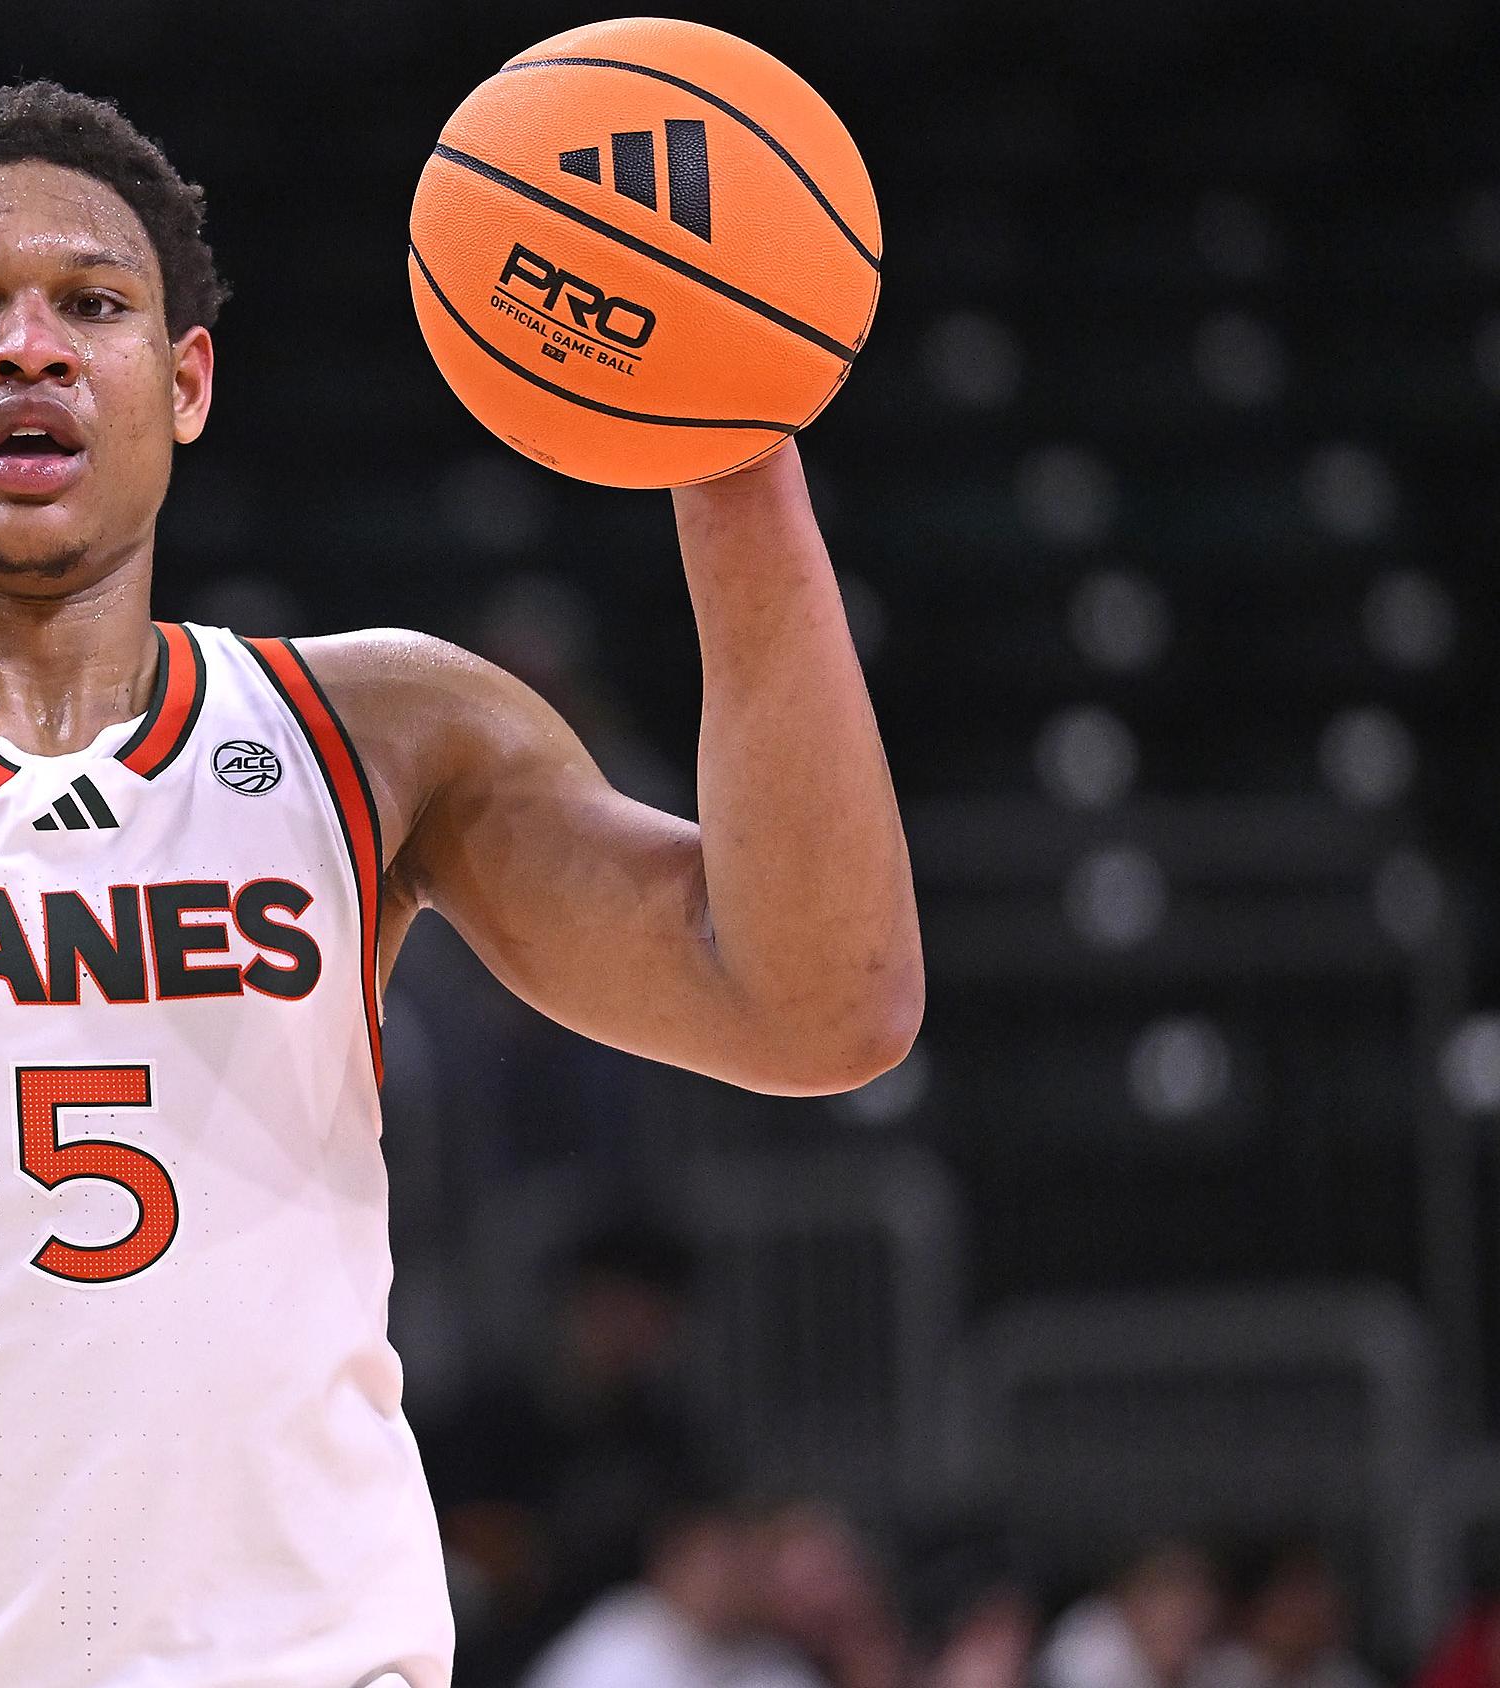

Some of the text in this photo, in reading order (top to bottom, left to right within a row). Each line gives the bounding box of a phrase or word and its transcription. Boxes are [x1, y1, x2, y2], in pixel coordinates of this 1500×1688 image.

[490, 295, 635, 376] OFFICIAL GAME BALL
[499, 242, 656, 349] PRO
[221, 755, 276, 770] ACC
[15, 1064, 179, 1284] 5
